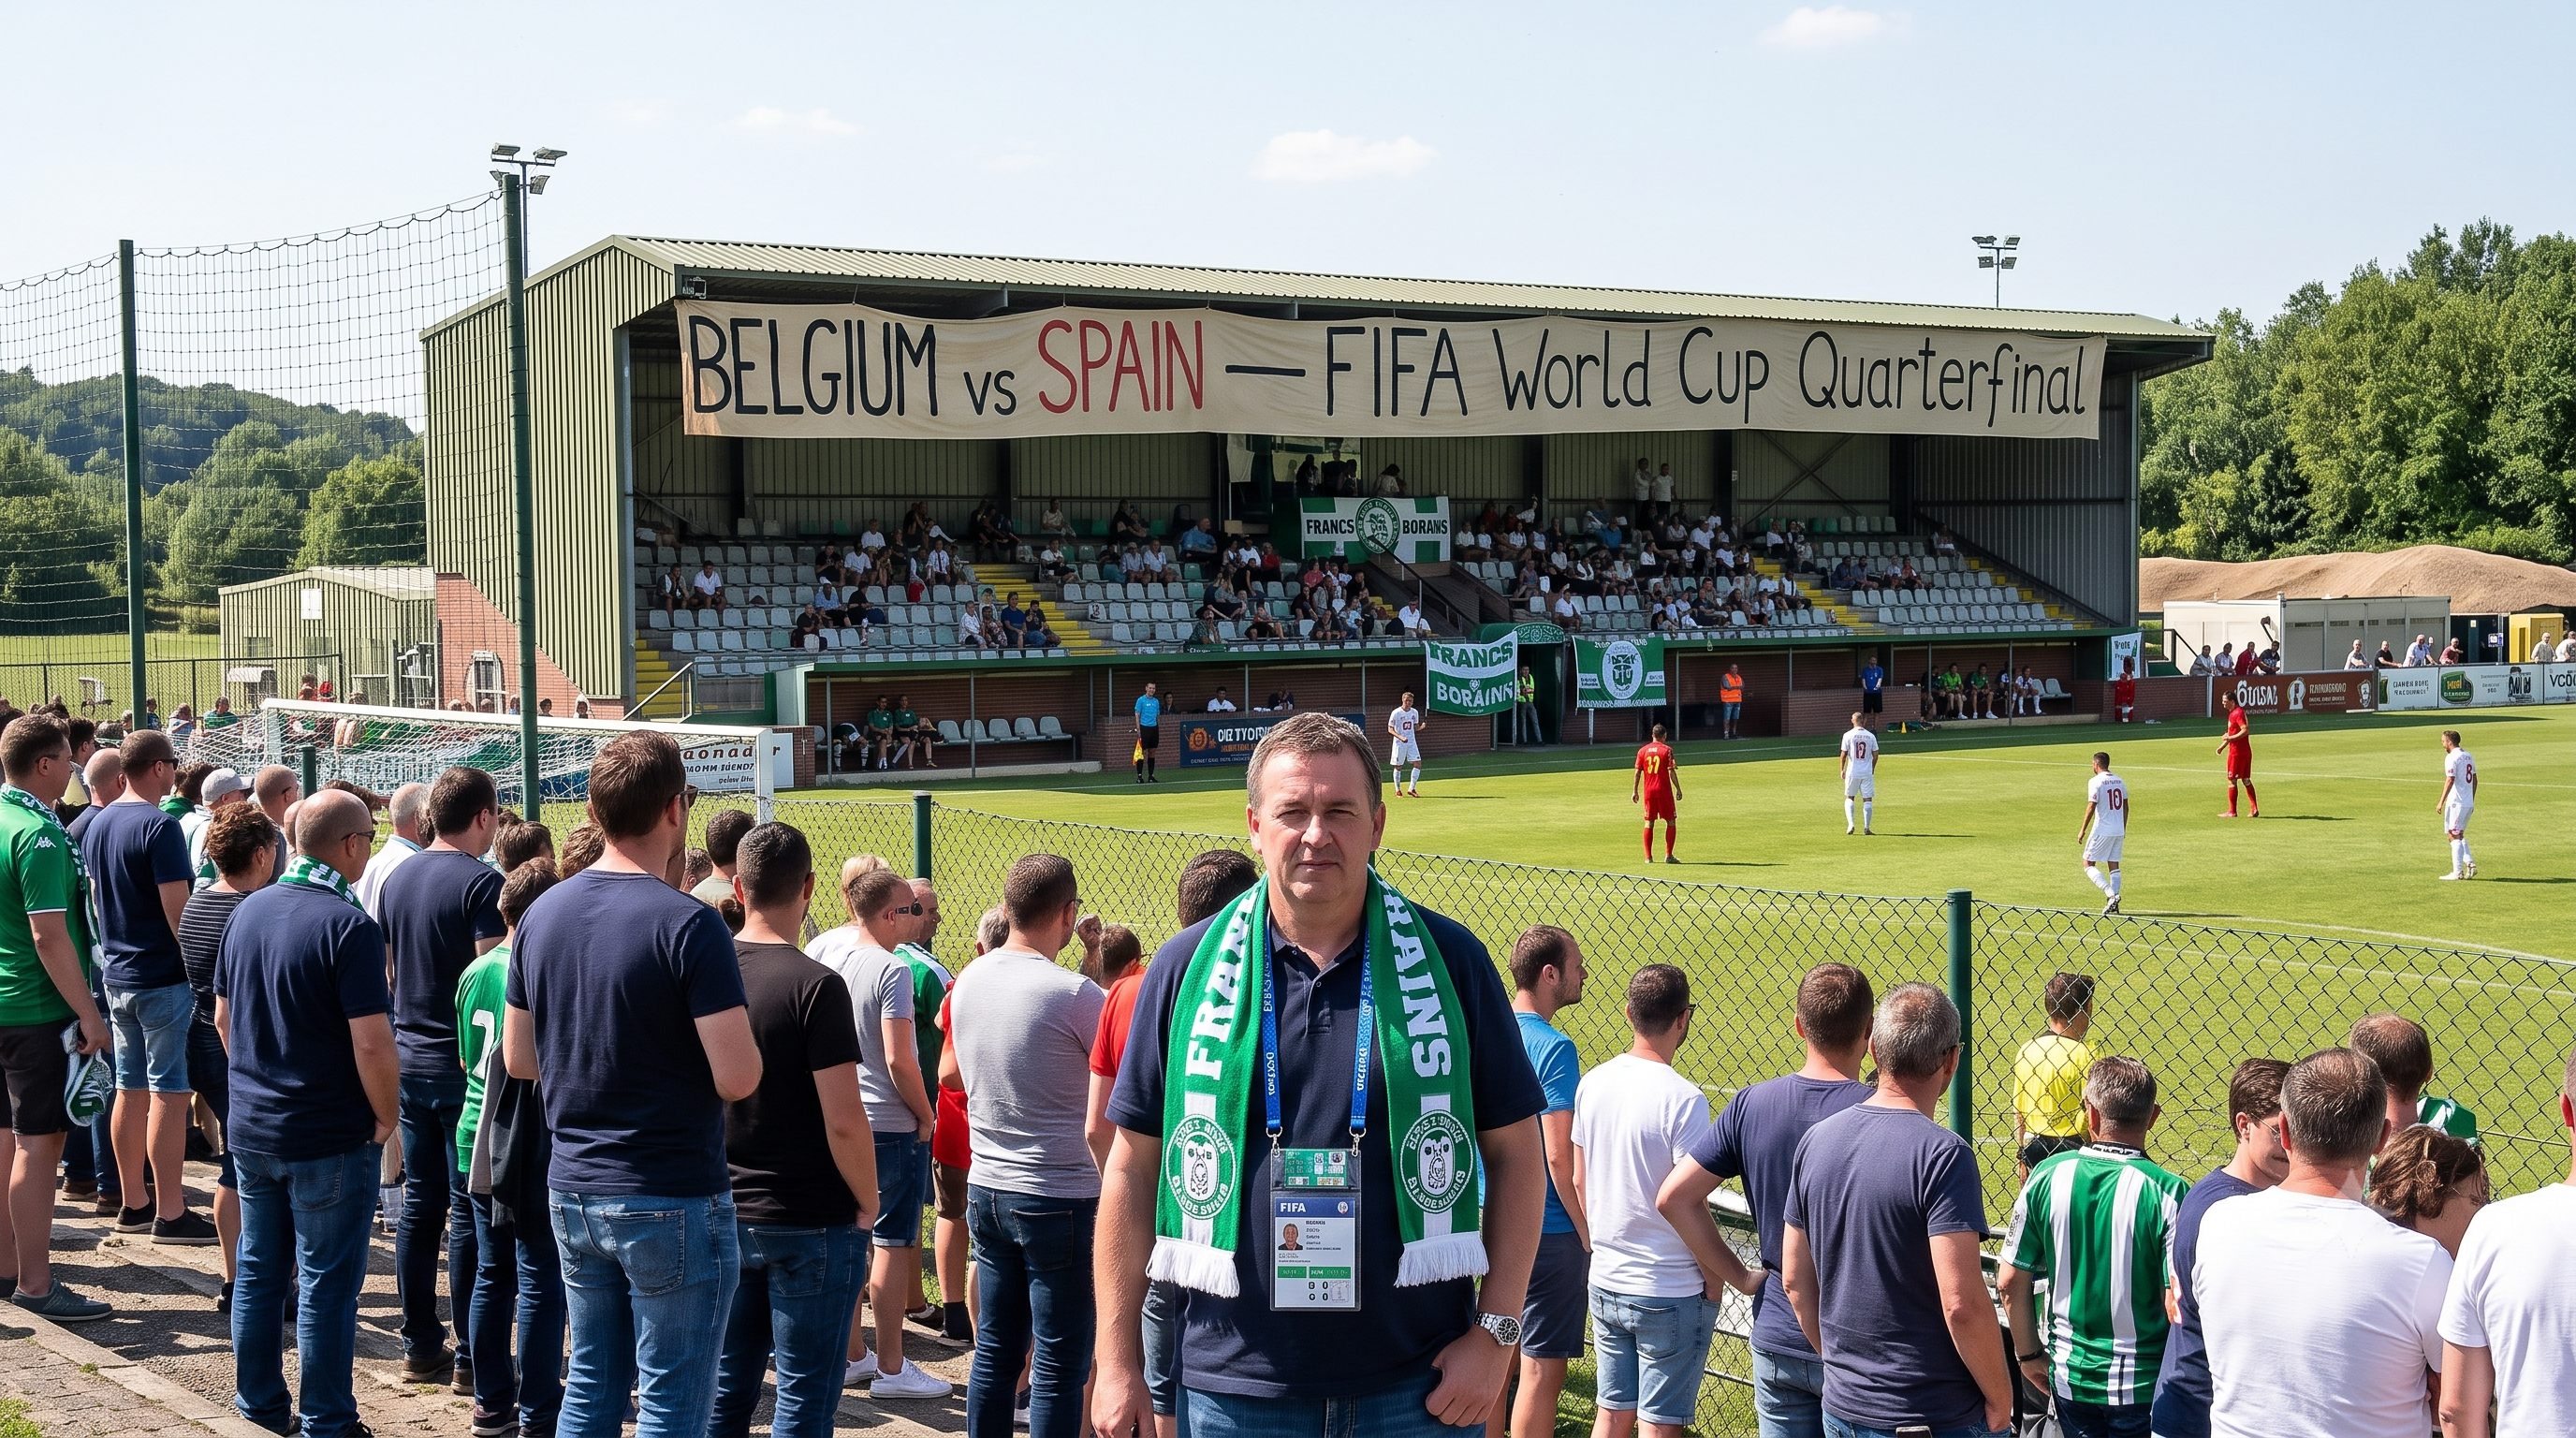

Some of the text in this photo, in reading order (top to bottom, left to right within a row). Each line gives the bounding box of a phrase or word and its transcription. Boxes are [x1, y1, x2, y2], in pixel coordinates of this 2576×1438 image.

[689, 315, 939, 416] BELGIUM
[963, 371, 1016, 416] vs
[1038, 319, 1203, 414] SPAIN
[1325, 326, 1468, 418] FIFA
[1492, 327, 1652, 411] World
[1678, 326, 1770, 425] Cup
[1798, 329, 2086, 428] Quarterfinal
[1306, 519, 1354, 535] FRANCS
[2107, 787, 2123, 811] 10
[1280, 1202, 1307, 1212] FIFA
